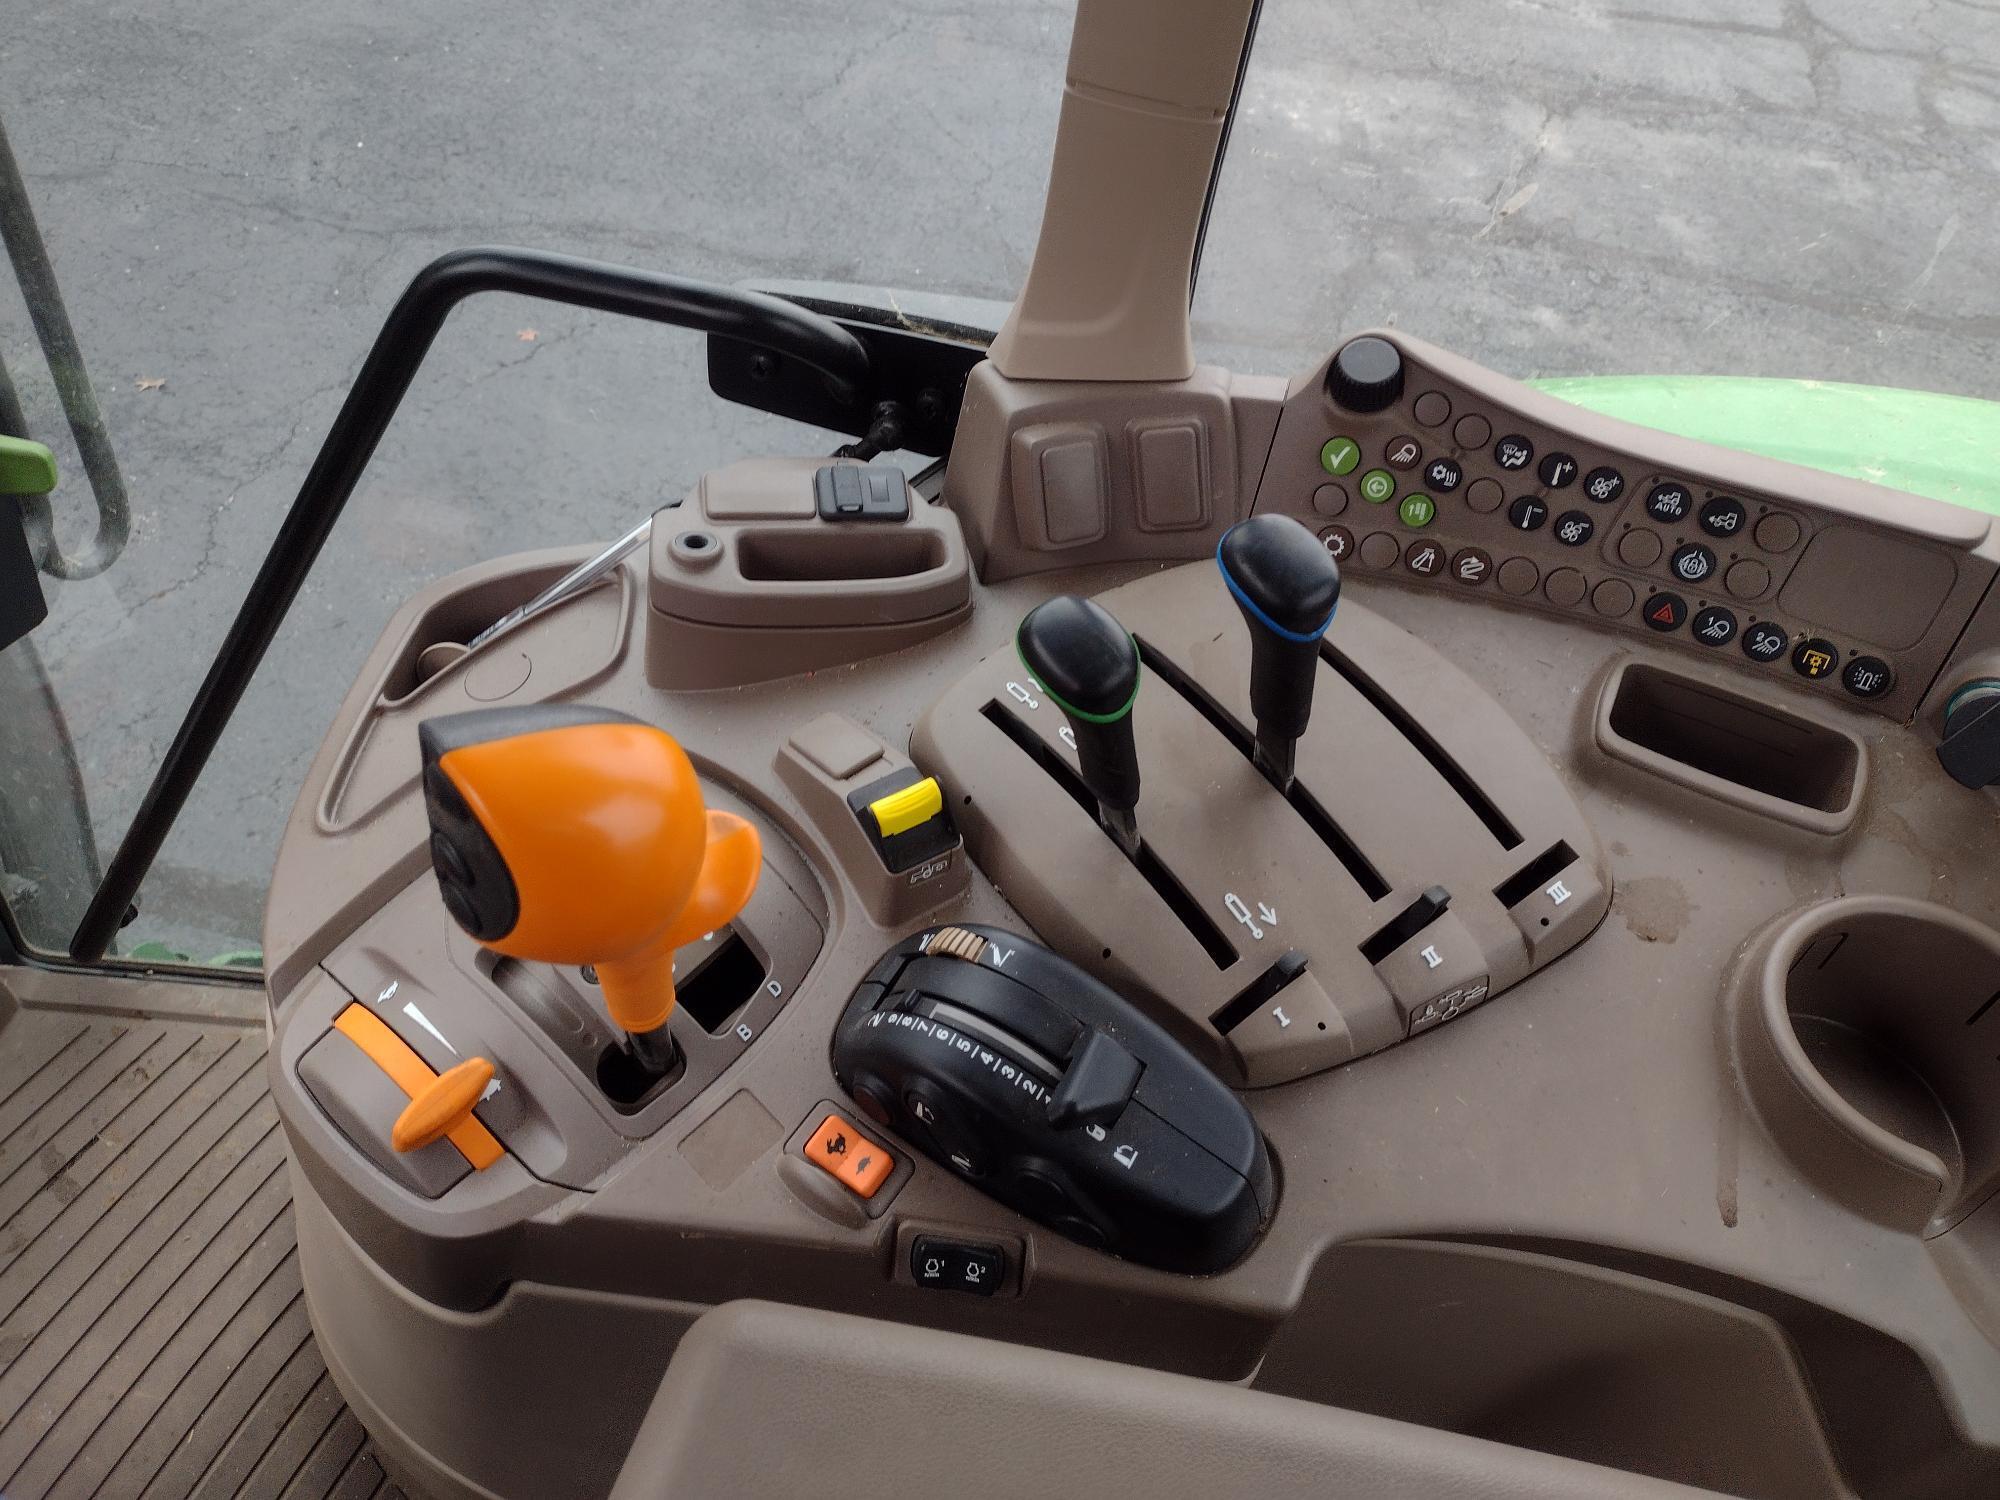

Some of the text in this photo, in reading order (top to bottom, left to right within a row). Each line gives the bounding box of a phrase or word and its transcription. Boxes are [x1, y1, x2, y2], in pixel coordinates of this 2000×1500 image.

[1654, 502, 1682, 516] AUTO
[1708, 616, 1715, 626] 1
[1756, 631, 1765, 642] 2
[766, 980, 782, 998] D
[736, 1023, 753, 1042] B
[902, 1015, 913, 1027] 8
[916, 1021, 928, 1032] 7
[937, 1028, 949, 1041] 6
[956, 1038, 971, 1053] 5
[980, 1050, 994, 1065] 4
[1001, 1064, 1015, 1080] 3
[1022, 1079, 1038, 1095] 2
